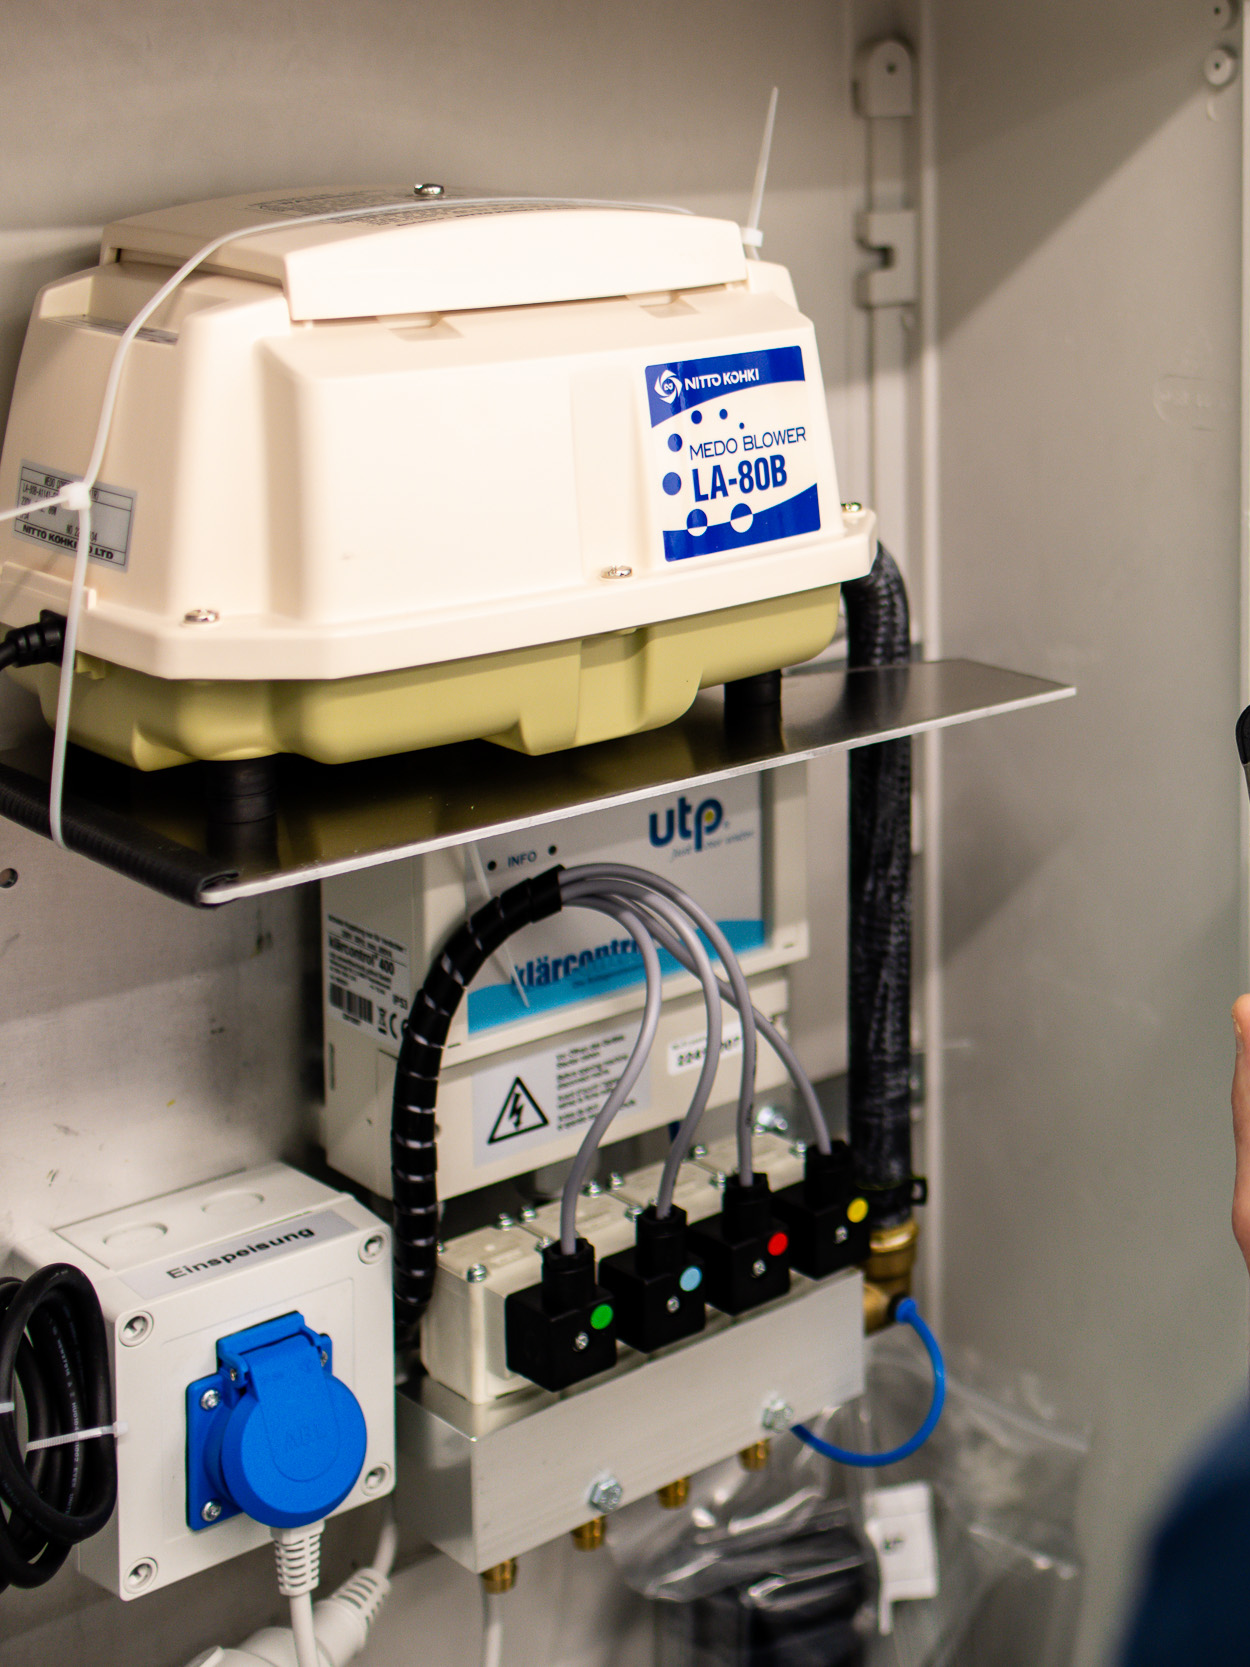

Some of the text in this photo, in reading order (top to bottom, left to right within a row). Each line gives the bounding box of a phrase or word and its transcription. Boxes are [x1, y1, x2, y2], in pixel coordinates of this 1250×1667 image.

[684, 368, 760, 391] NITTO KOHKI
[689, 426, 807, 460] MEDO BLOWER
[691, 454, 788, 502] LA-80B
[22, 524, 47, 539] NITTO
[649, 796, 723, 852] utp
[508, 849, 537, 867] INFO
[166, 1226, 315, 1280] Einspeisung
